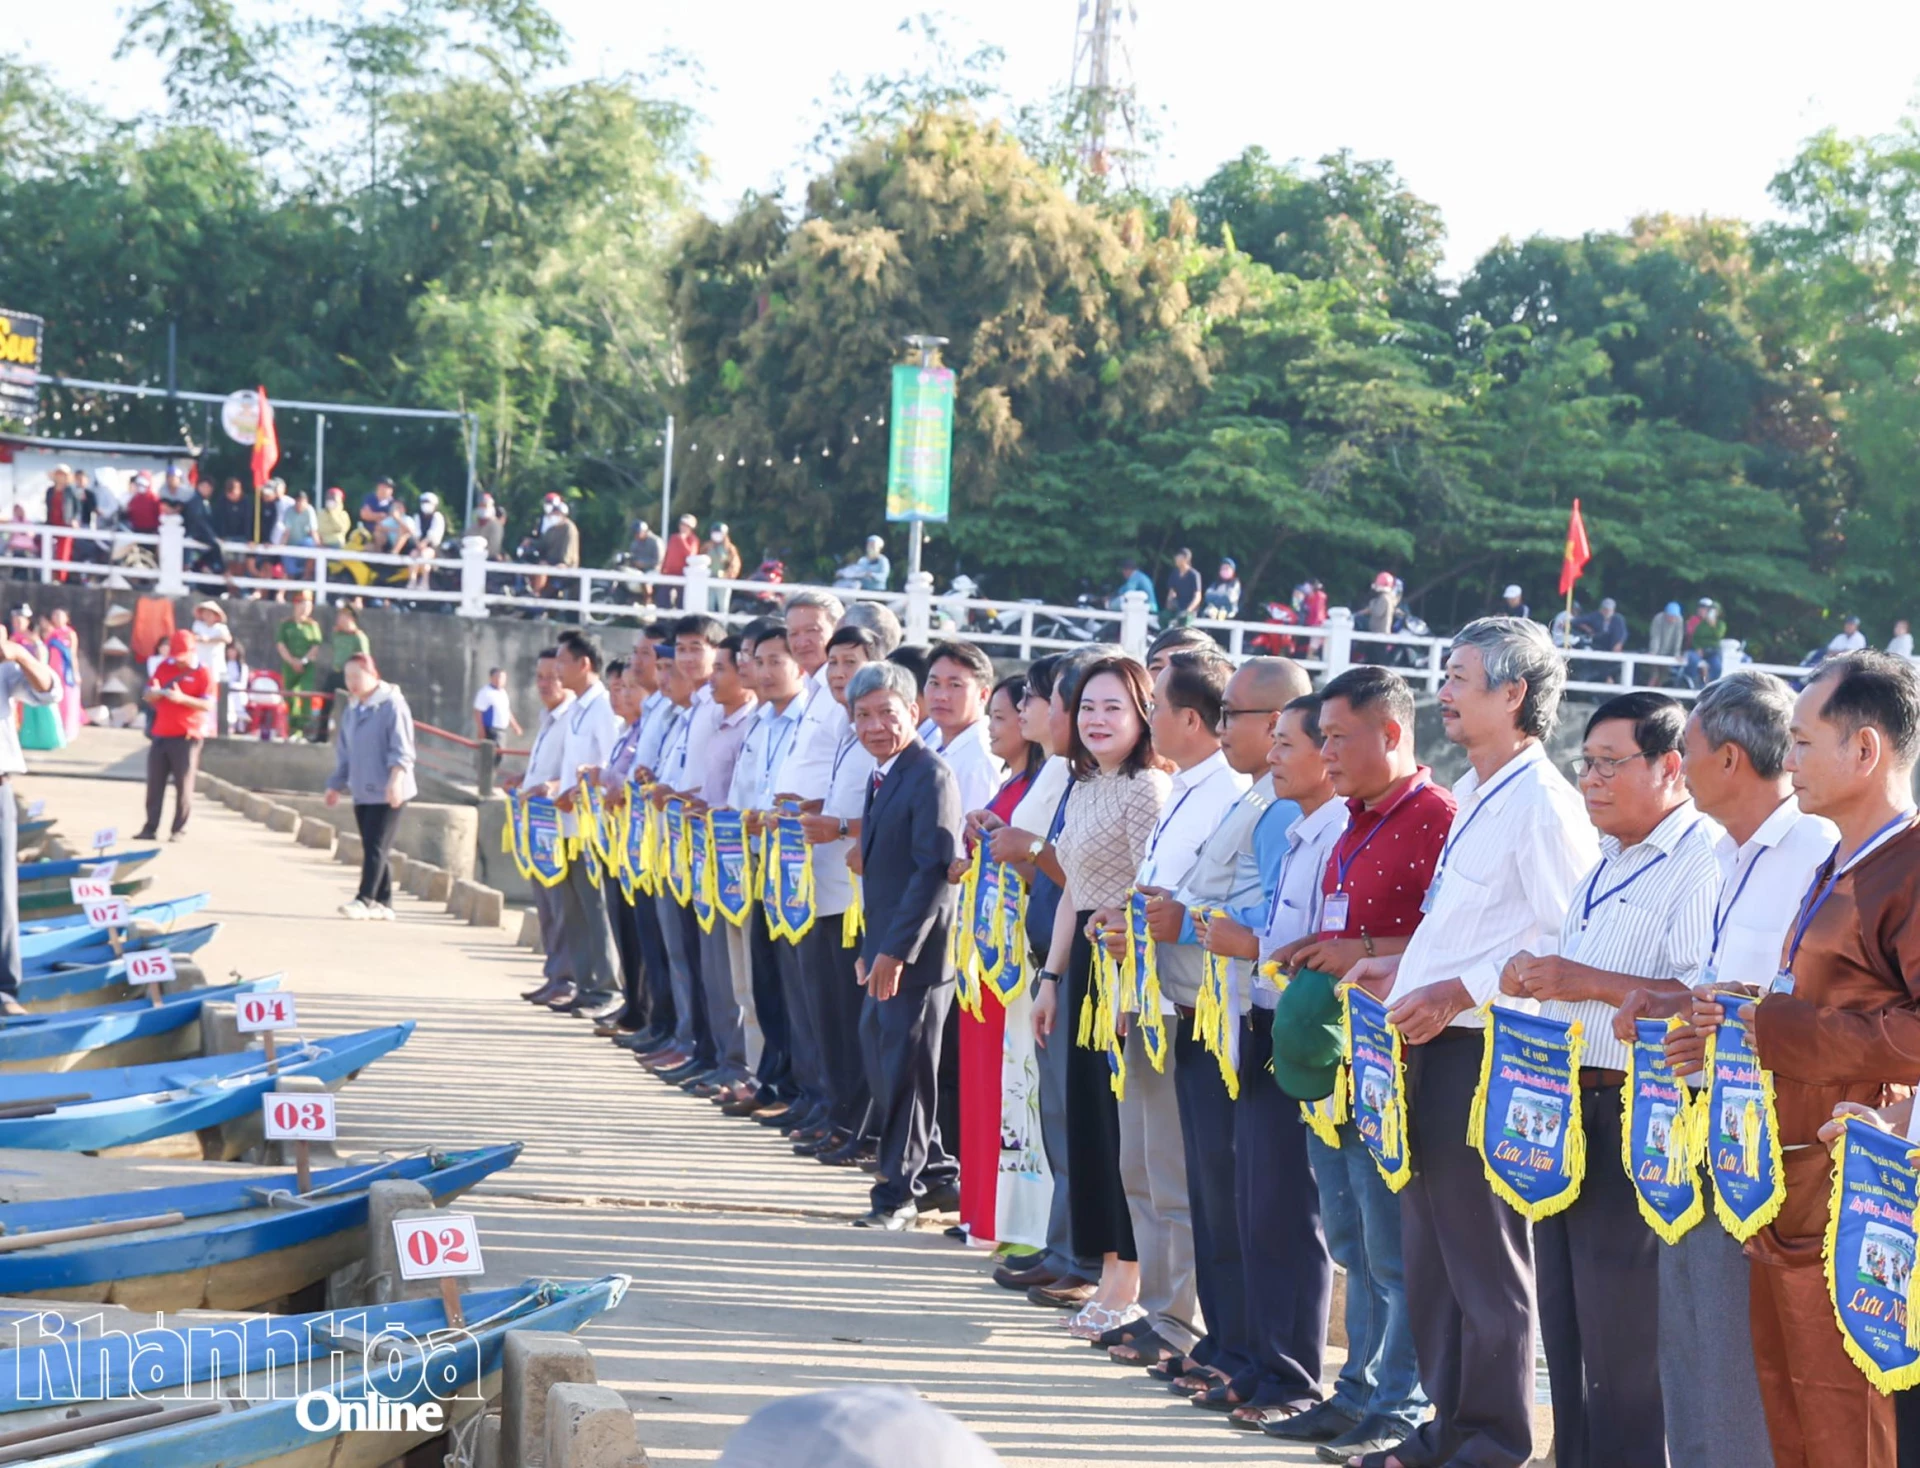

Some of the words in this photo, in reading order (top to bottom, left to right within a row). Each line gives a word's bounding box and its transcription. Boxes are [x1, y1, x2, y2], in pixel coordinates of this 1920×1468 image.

[77, 883, 105, 898] 08
[92, 904, 119, 923] 07
[132, 956, 167, 977] 05
[244, 998, 288, 1024] 04
[274, 1101, 327, 1132] 03
[407, 1227, 470, 1267] 02
